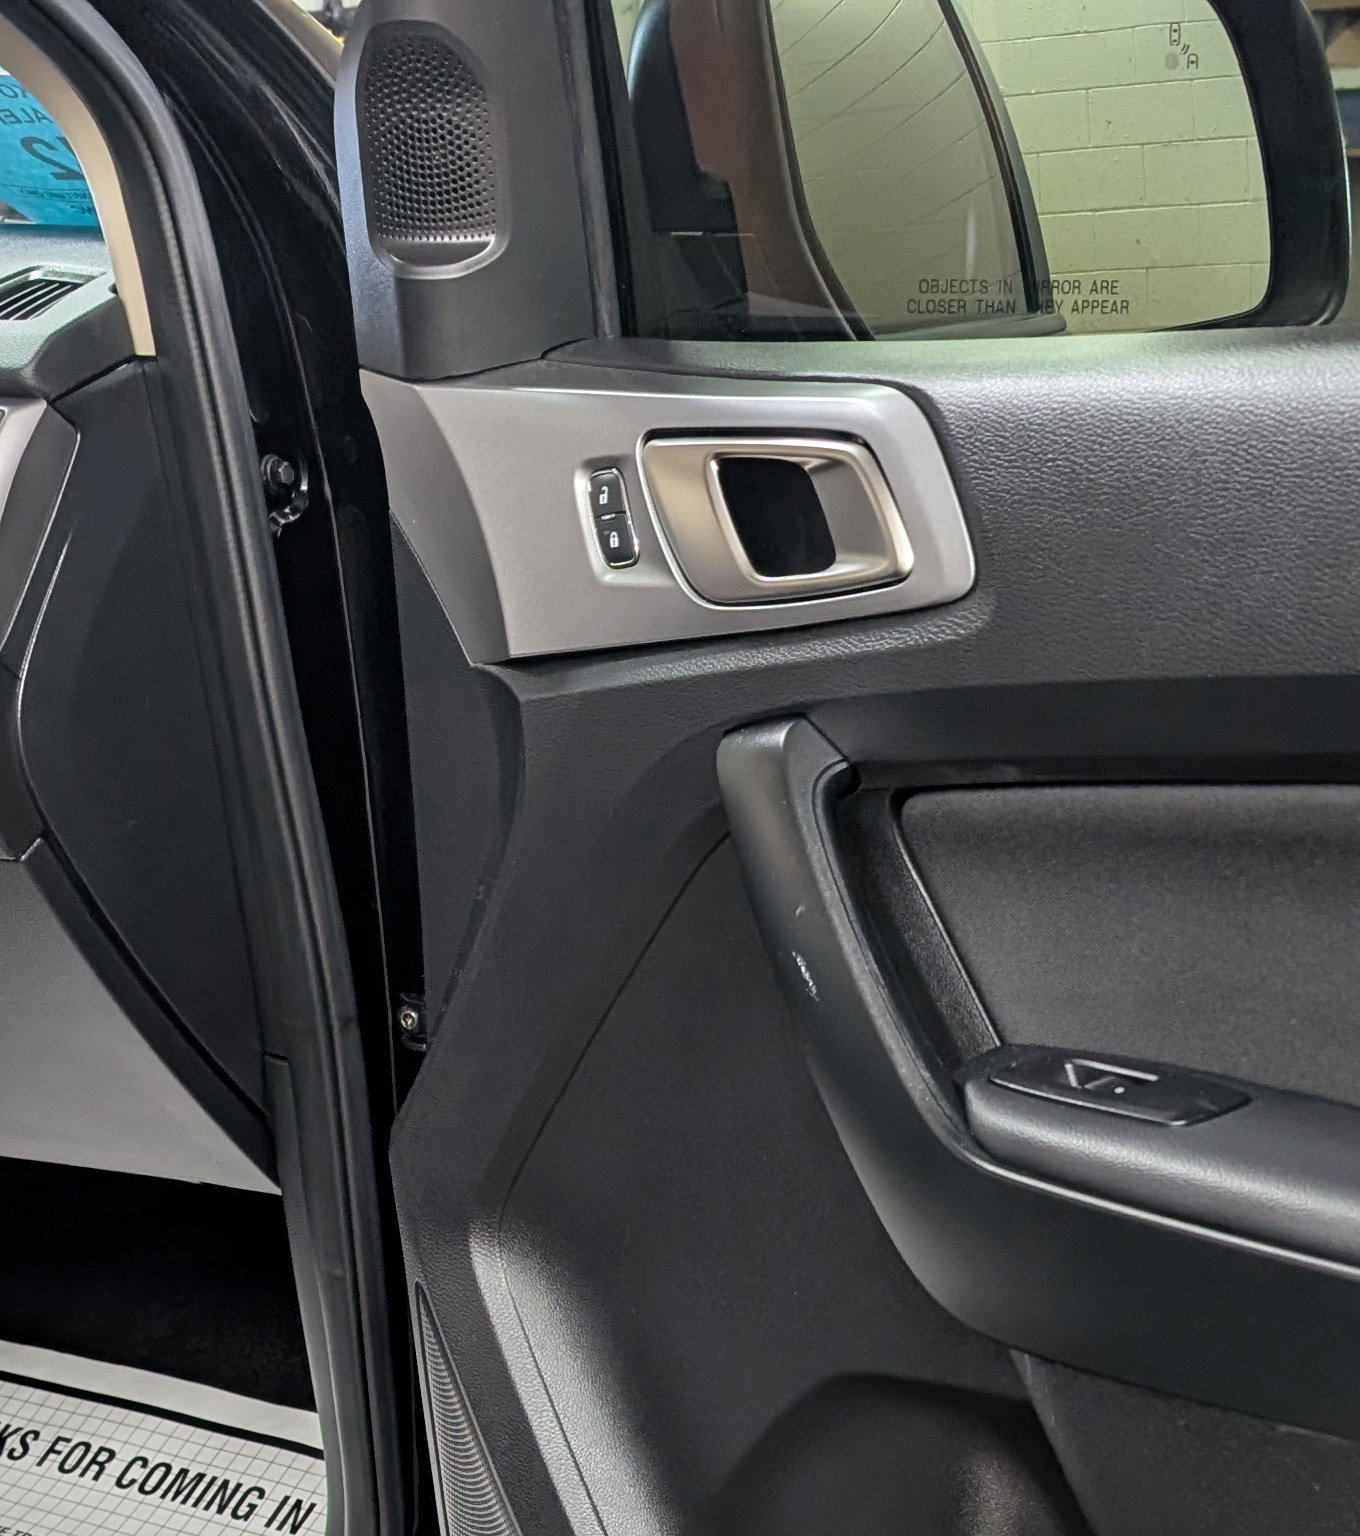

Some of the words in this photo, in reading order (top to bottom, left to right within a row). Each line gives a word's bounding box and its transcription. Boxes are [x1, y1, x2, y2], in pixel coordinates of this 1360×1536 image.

[918, 278, 989, 294] OBJECTS
[998, 279, 1013, 294] IN
[1089, 280, 1120, 295] ARE
[907, 299, 967, 315] CLOSER
[976, 299, 1016, 315] THAN
[1070, 300, 1129, 315] APPEAR
[36, 1436, 116, 1482] FOR
[115, 1456, 266, 1522] COMING
[264, 1495, 316, 1536] IN
